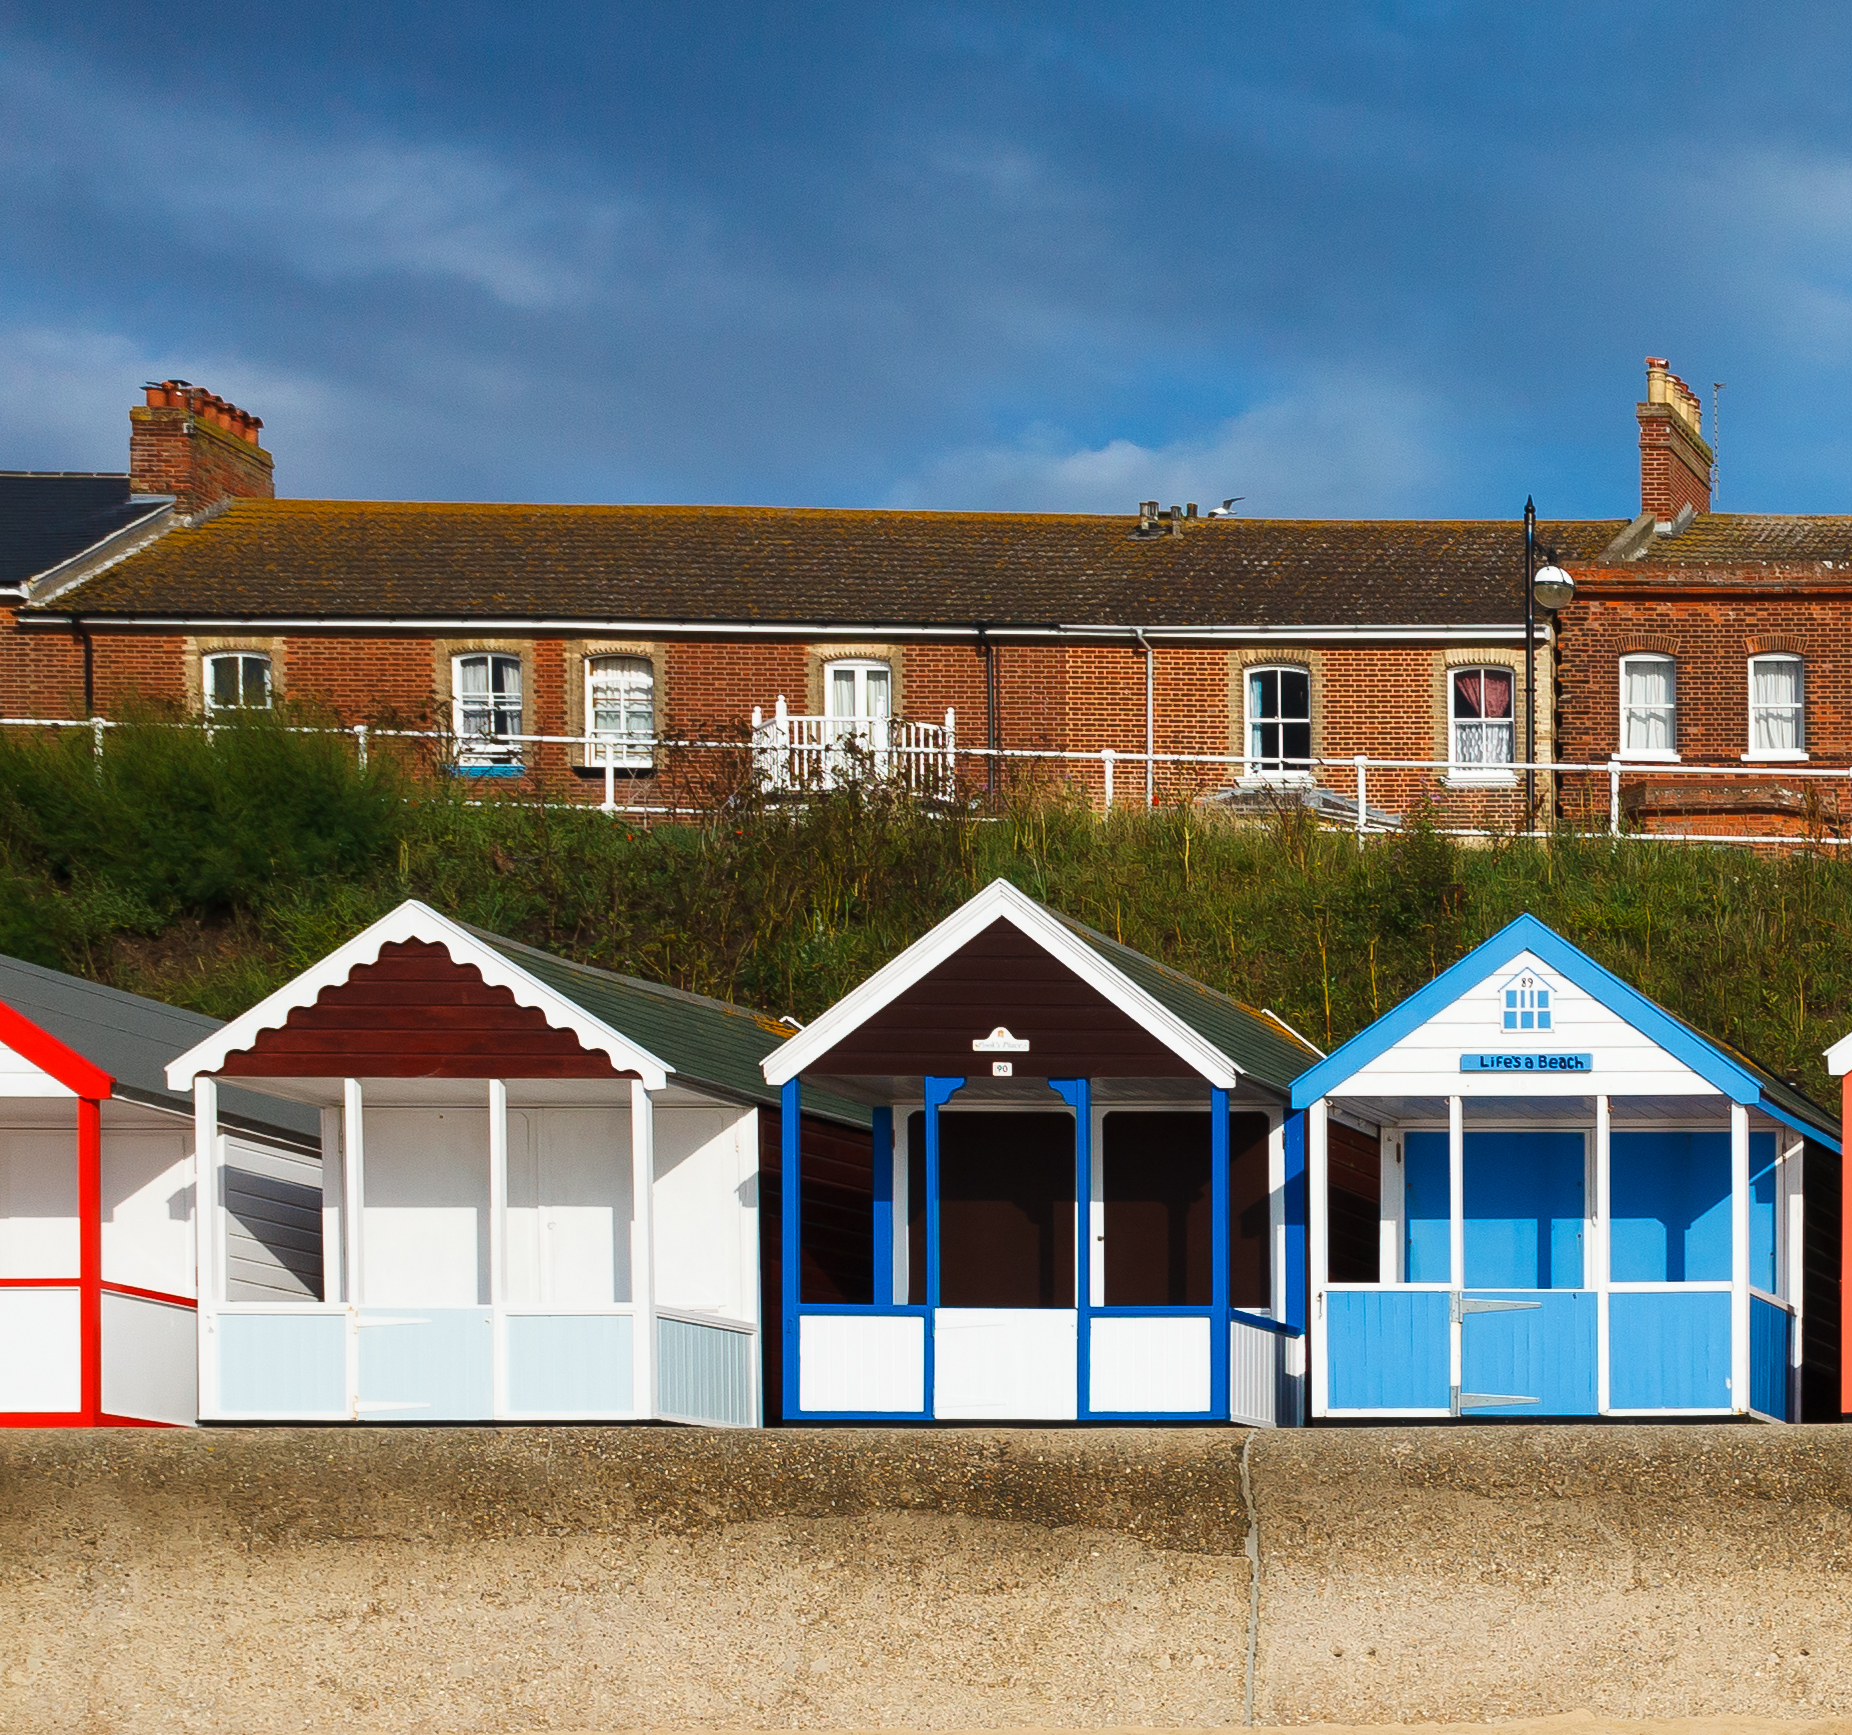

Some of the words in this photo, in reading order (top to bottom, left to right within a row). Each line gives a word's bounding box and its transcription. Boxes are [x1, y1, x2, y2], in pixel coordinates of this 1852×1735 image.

[1521, 977, 1534, 988] 89
[1480, 1055, 1521, 1069] Life's
[1524, 1057, 1534, 1069] a
[1538, 1055, 1585, 1069] Beach
[996, 1064, 1009, 1073] 90
